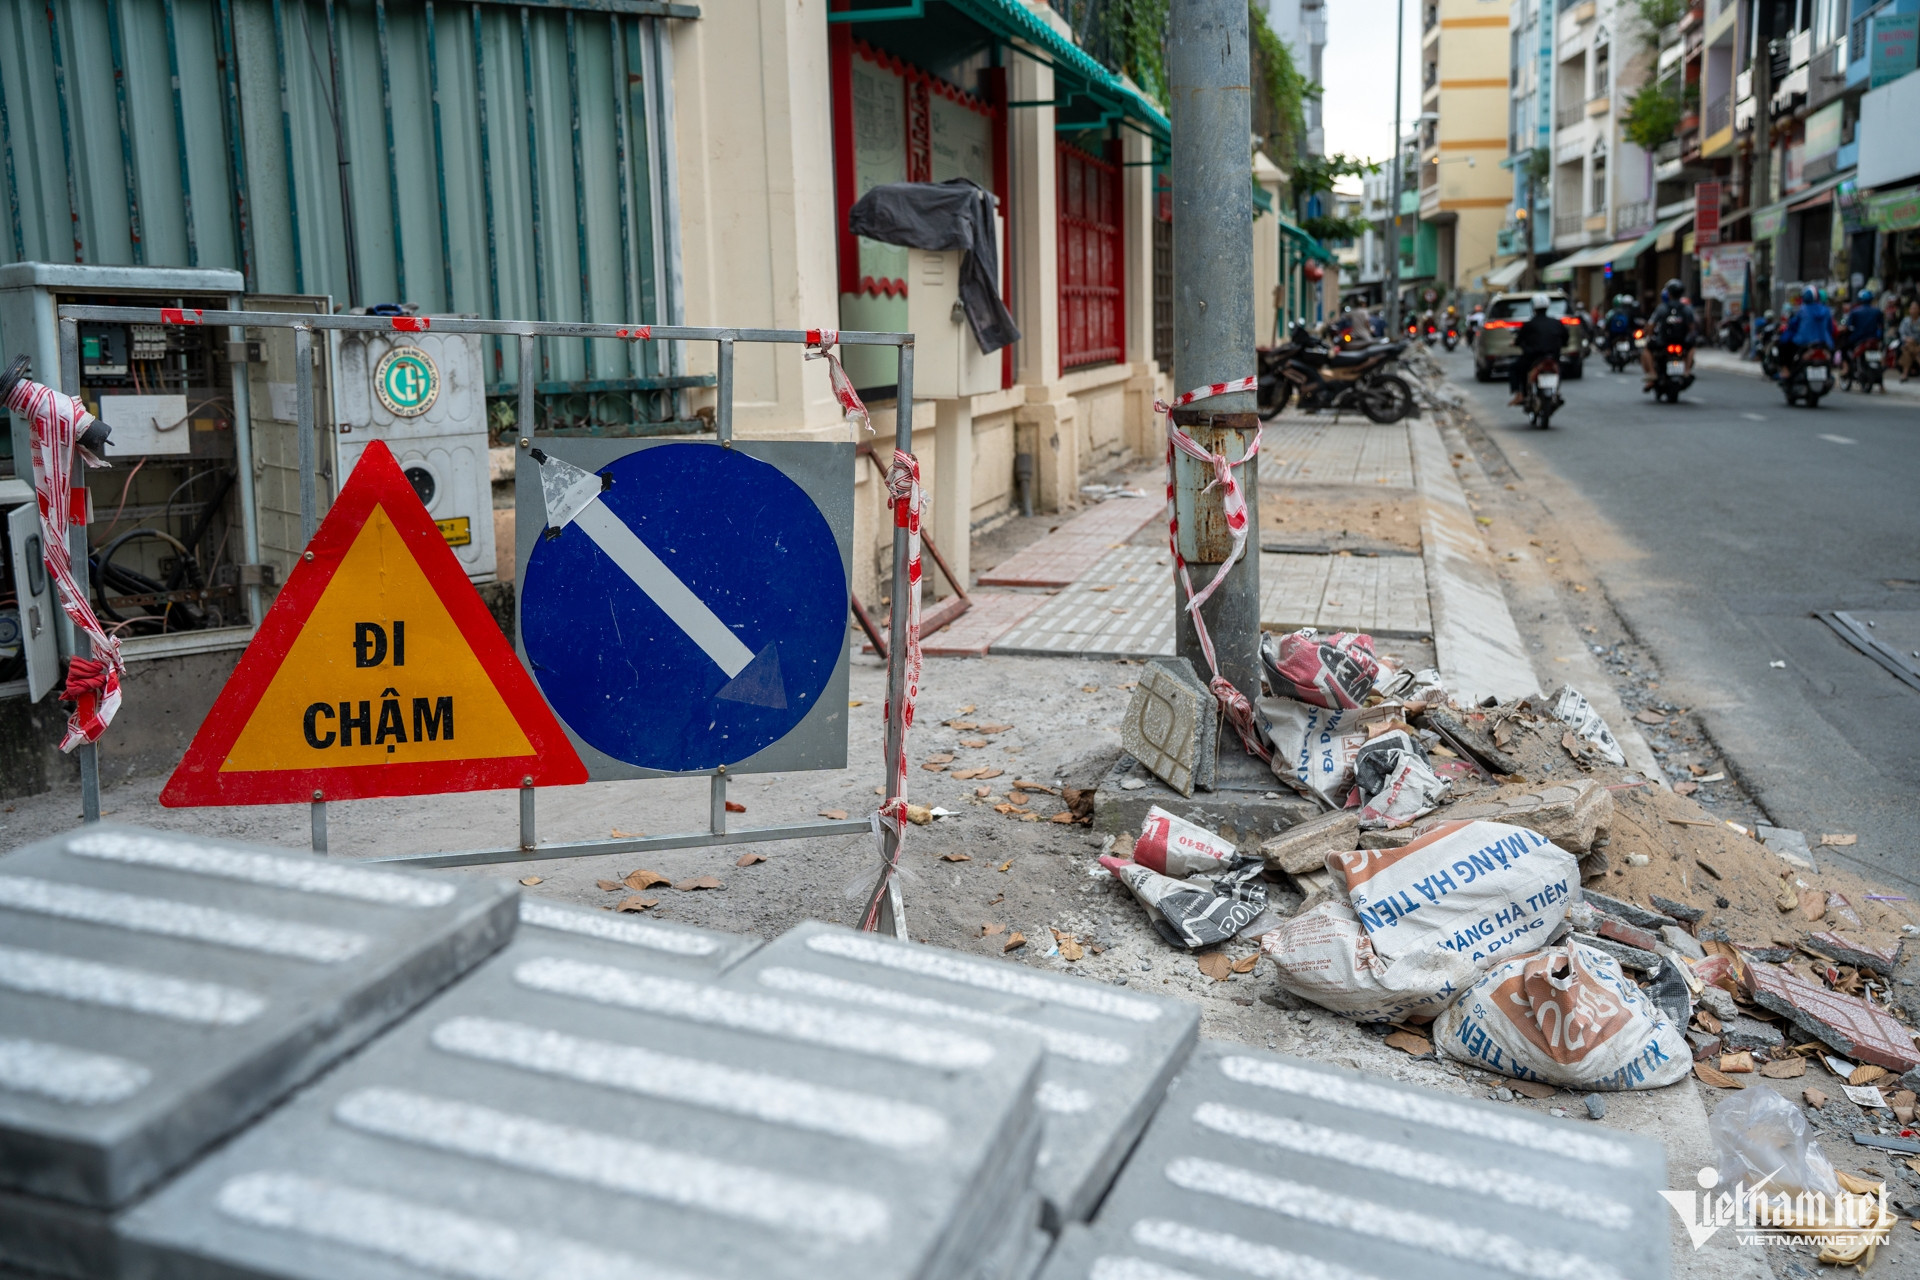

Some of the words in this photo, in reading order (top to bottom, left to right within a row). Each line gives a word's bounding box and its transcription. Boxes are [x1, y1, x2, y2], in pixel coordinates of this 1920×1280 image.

[353, 620, 405, 668] ĐI
[303, 687, 454, 753] CHẬM
[1322, 749, 1334, 773] ĐA
[1179, 835, 1225, 861] PCB40
[1452, 832, 1530, 884] MĂNG
[1412, 869, 1458, 905] HÀ
[1495, 901, 1527, 928] HÀ
[1526, 878, 1569, 913] TIÊN
[1558, 895, 1570, 907] SG
[1358, 890, 1421, 934] TIÊN
[1487, 917, 1545, 953] DỤNG
[1434, 980, 1458, 1001] XI
[1472, 1003, 1487, 1020] SG
[1455, 1015, 1504, 1071] TIÊN
[1643, 1039, 1670, 1073] XI
